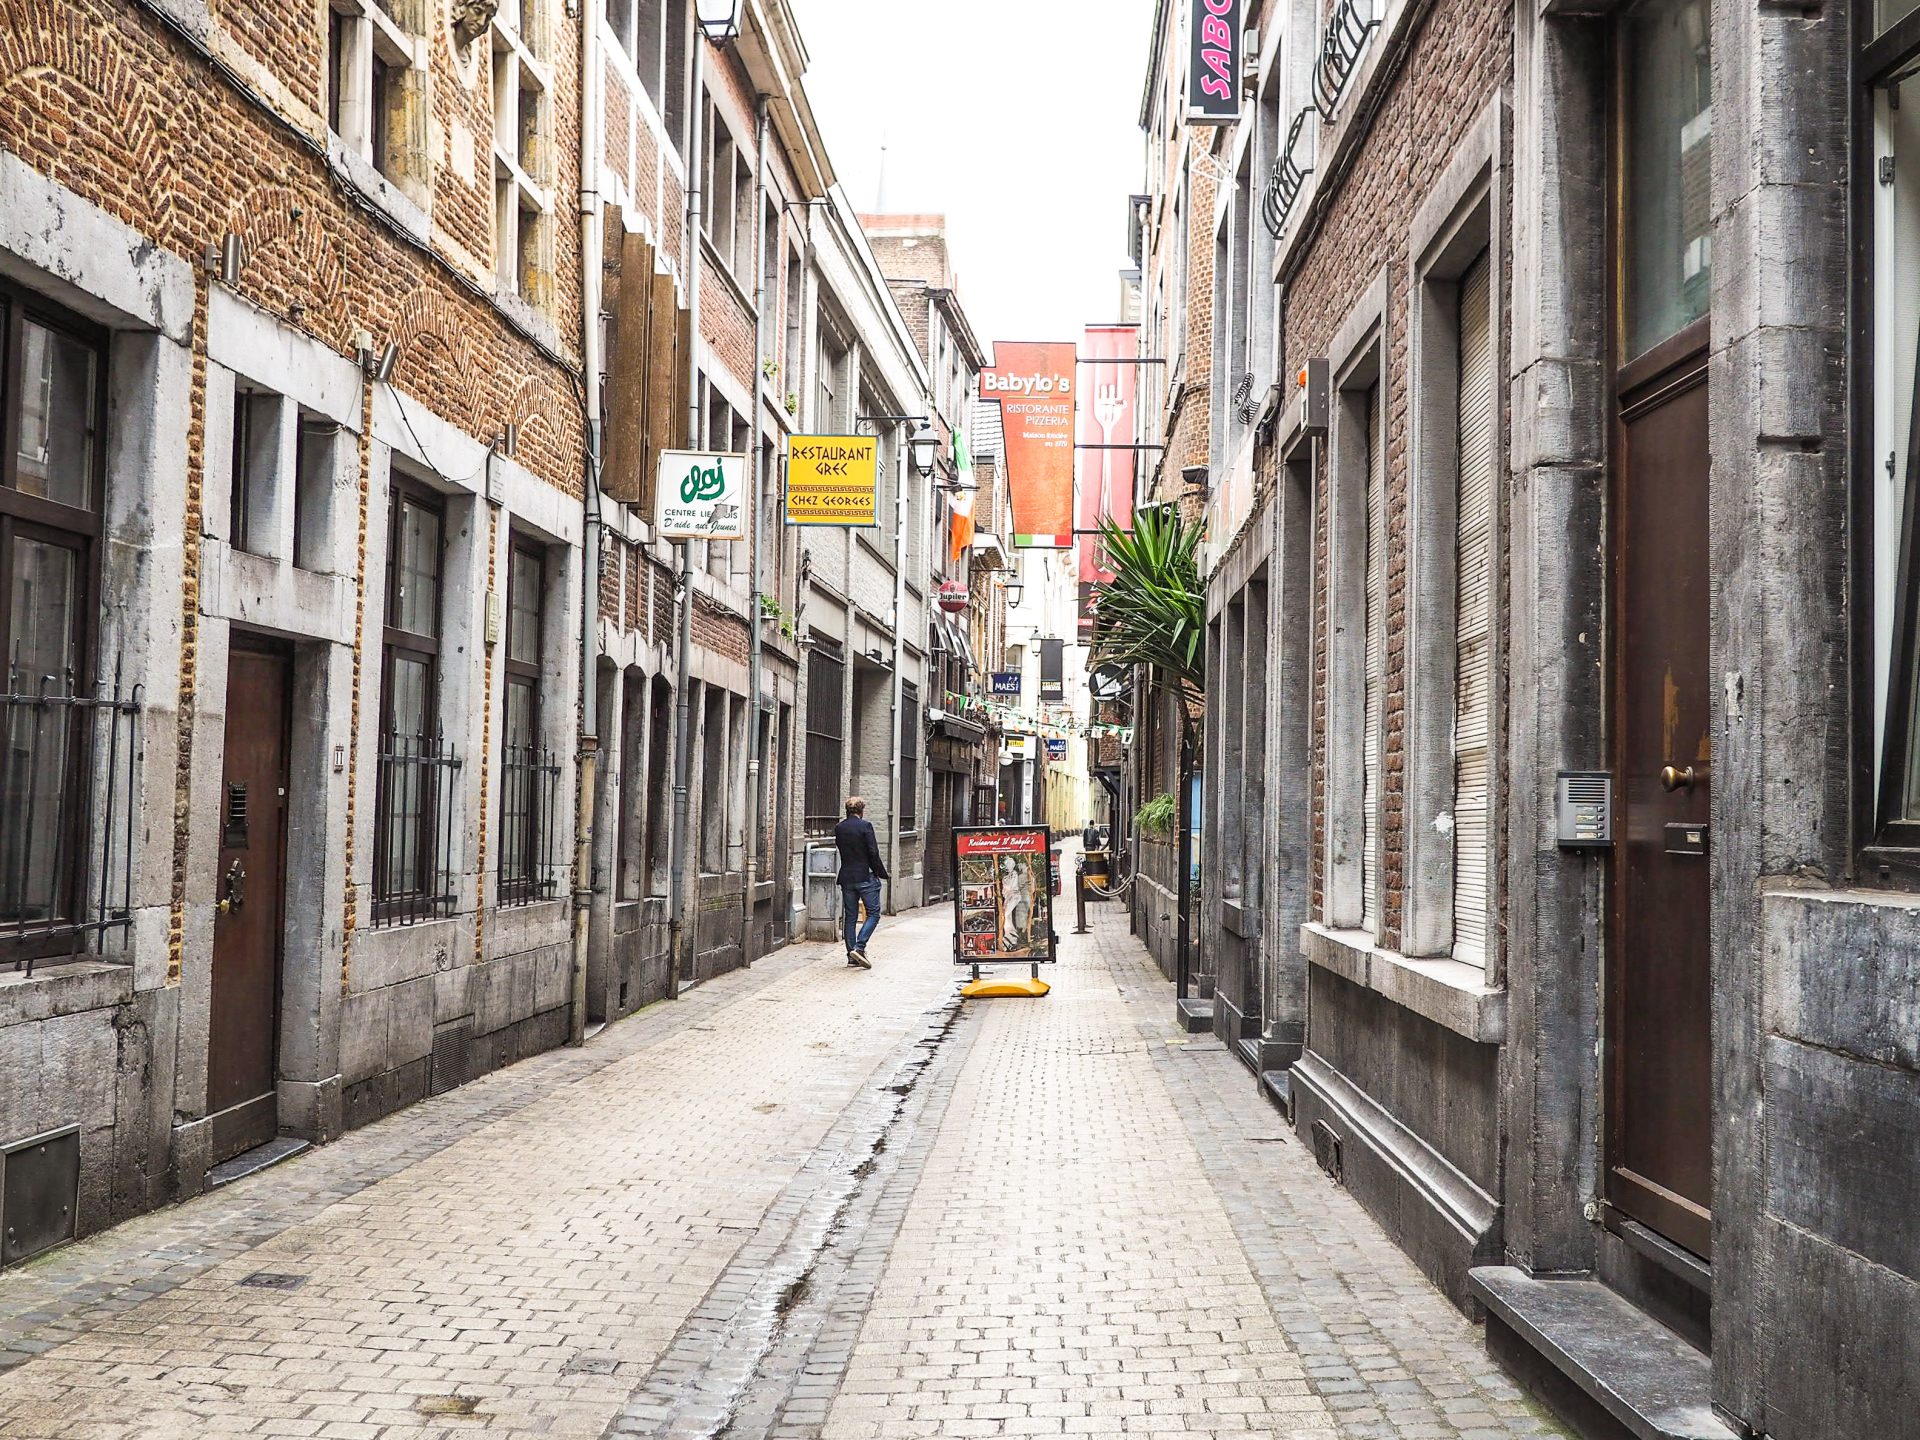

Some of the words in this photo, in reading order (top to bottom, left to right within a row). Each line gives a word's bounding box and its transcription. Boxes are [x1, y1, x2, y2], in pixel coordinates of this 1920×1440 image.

[984, 372, 1070, 396] Babylo's
[1006, 404, 1069, 414] RISTORANTE
[1025, 415, 1069, 425] PIZZERIA
[792, 446, 872, 461] RESTAURANT
[815, 462, 848, 476] GREC
[791, 495, 818, 506] CHEZ
[822, 495, 871, 506] GEORGES
[664, 508, 696, 517] CENTRE
[700, 509, 738, 519] LIEOIS
[709, 520, 737, 535] Jeunes
[939, 592, 967, 601] Jupiler
[994, 682, 1015, 691] MAES
